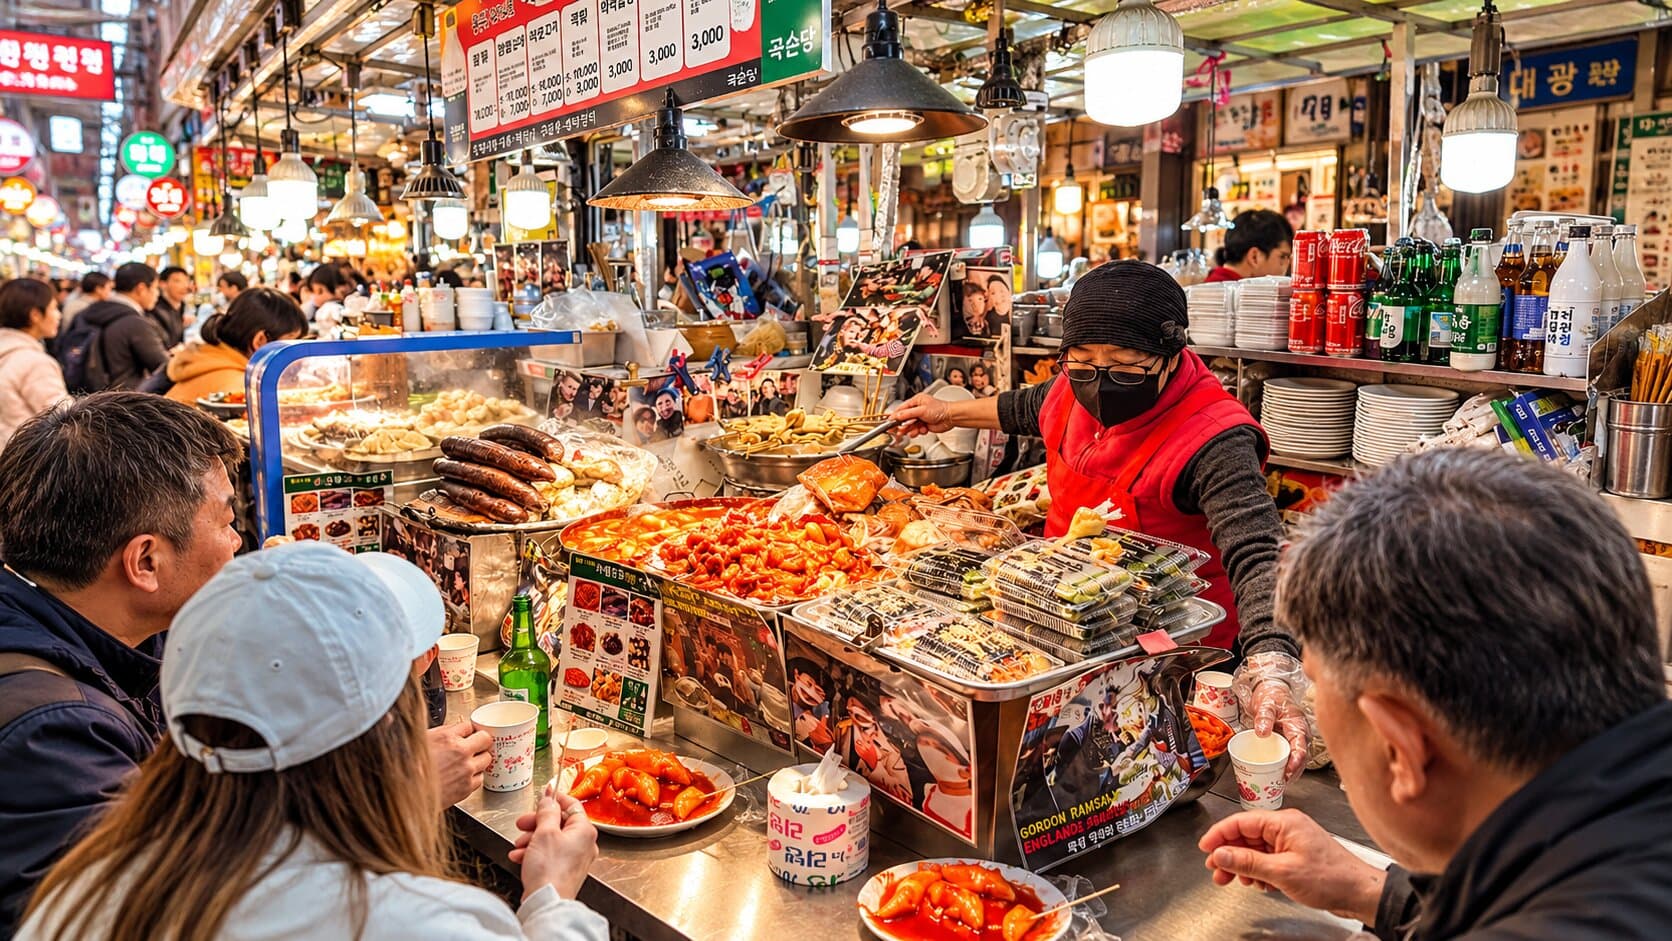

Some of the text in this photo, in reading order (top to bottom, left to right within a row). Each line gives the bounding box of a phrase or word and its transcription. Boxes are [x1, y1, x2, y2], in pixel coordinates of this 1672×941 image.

[691, 25, 724, 51] 3,000
[648, 42, 677, 66] 3,000
[608, 58, 633, 79] 3,000
[576, 76, 599, 96] 3,000
[1019, 811, 1067, 840] GORDON
